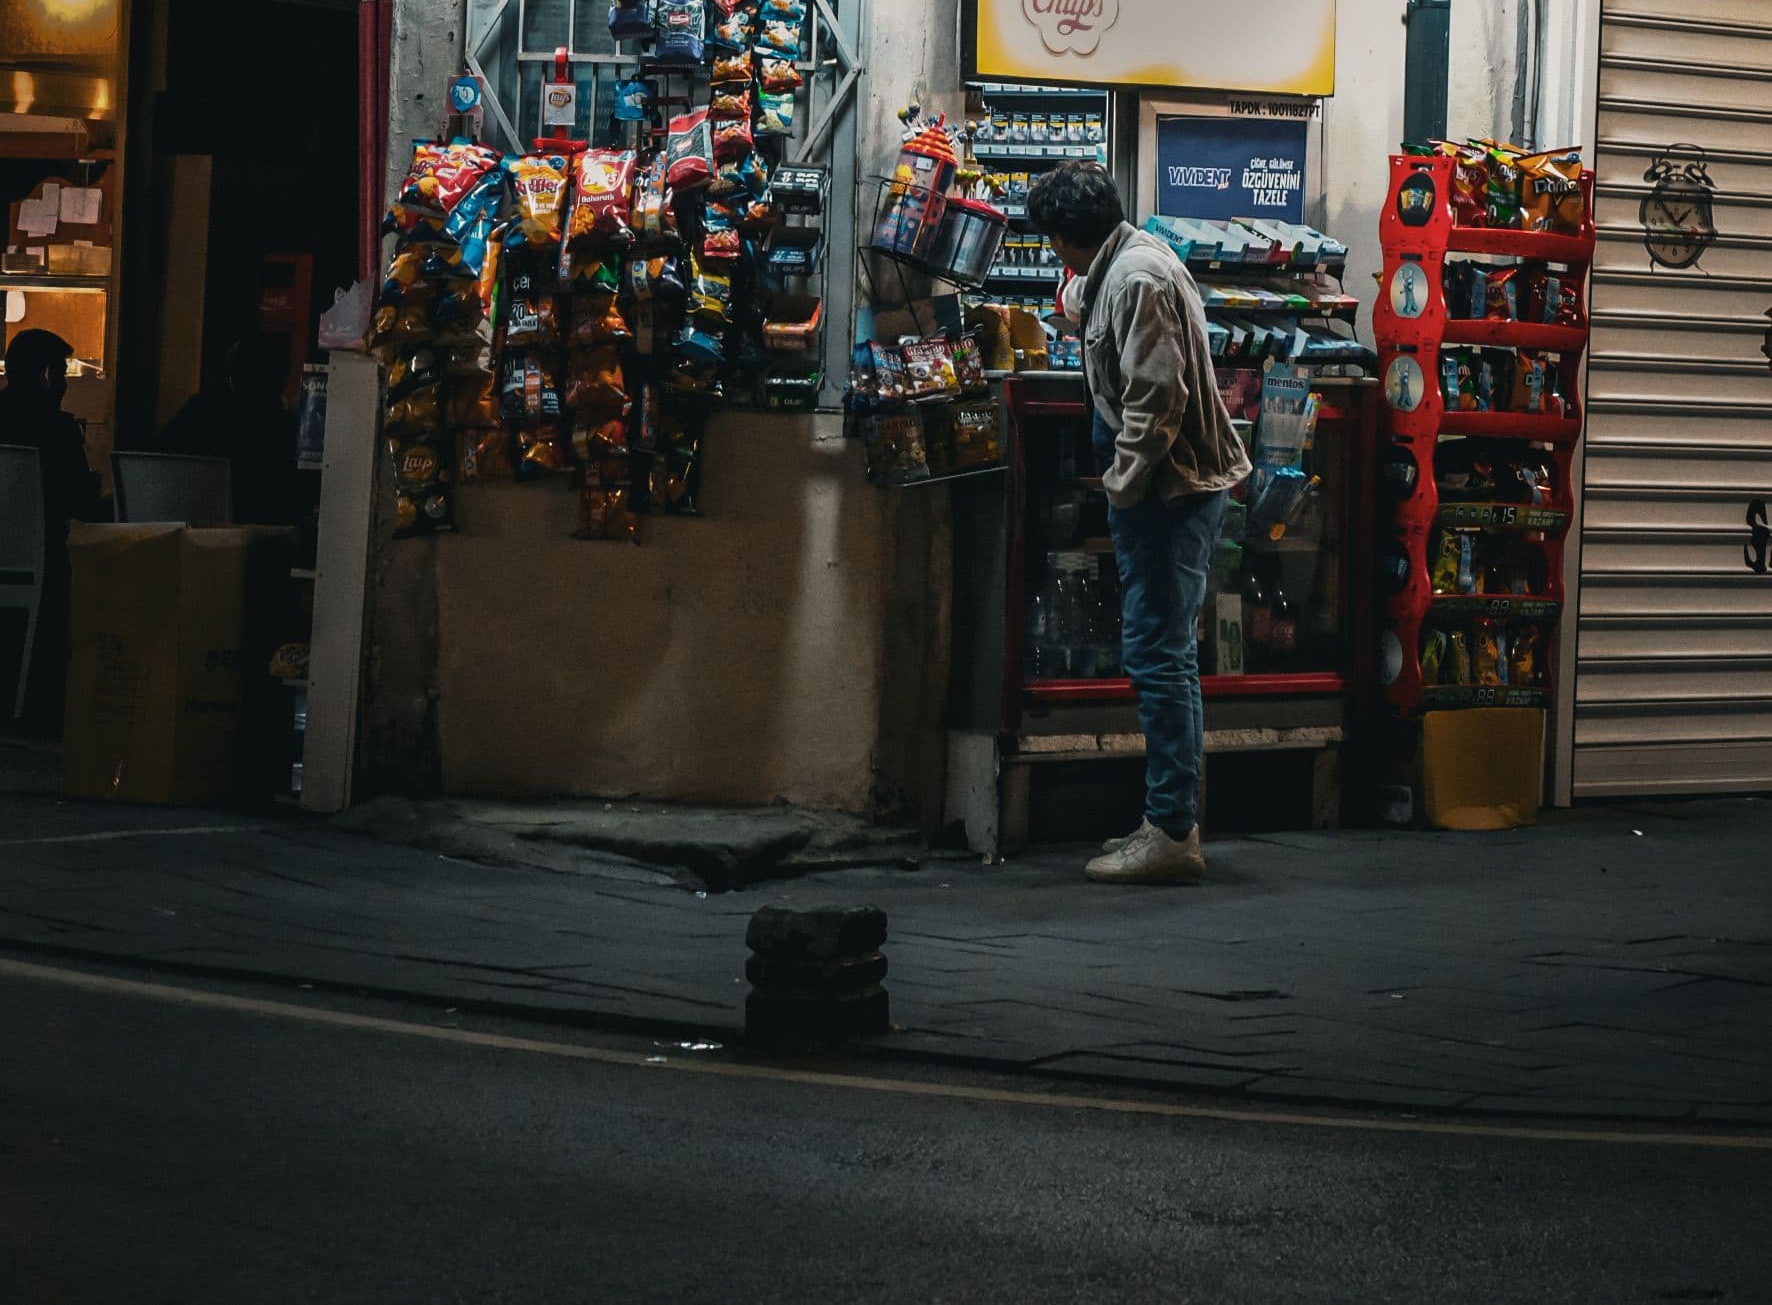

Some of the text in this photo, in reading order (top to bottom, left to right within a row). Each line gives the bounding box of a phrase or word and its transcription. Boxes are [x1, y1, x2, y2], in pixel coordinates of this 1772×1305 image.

[1229, 100, 1261, 115] TAPDK
[1253, 189, 1288, 206] TAZELE
[1267, 377, 1305, 390] mentos
